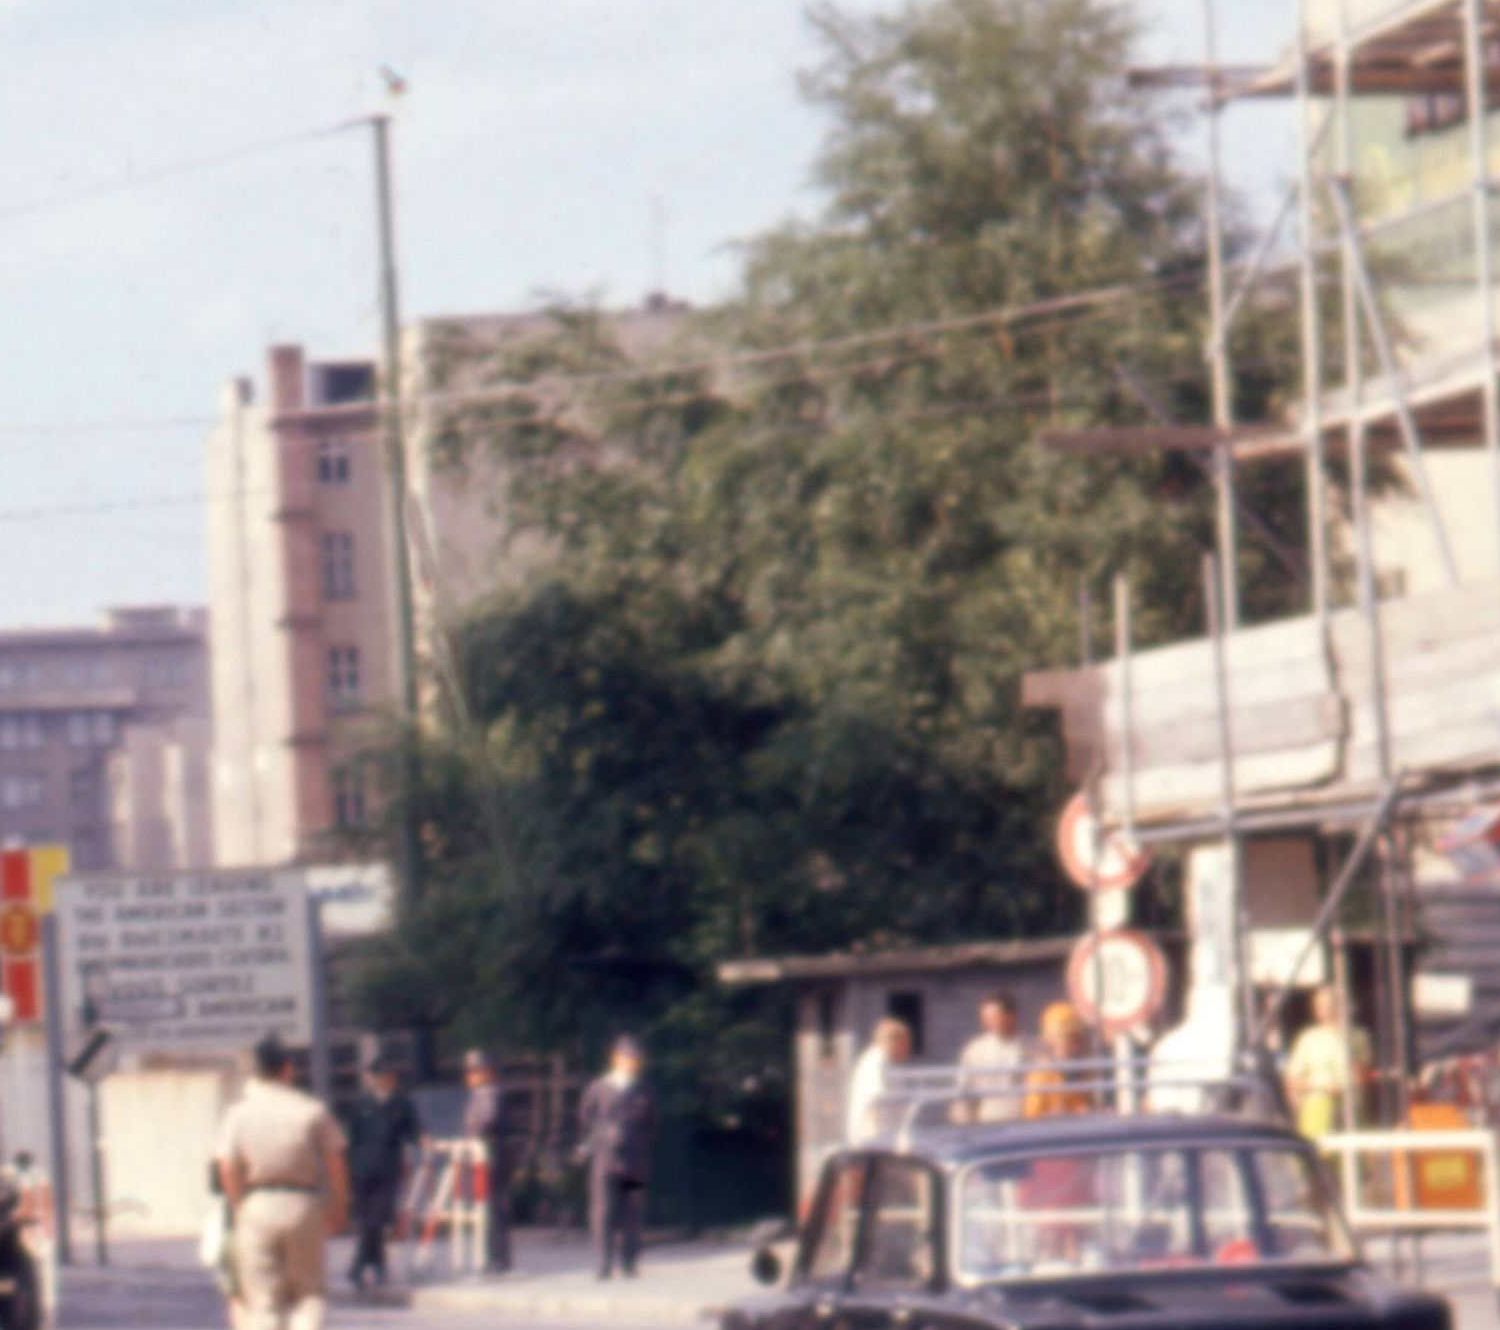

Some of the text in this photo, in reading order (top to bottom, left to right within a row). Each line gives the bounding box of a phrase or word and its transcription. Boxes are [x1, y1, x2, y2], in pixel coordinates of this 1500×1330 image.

[84, 873, 275, 898] YOU ARE LEAVING
[74, 897, 287, 923] THE AMERICAN SECTOR
[178, 974, 254, 995] SORTEZ
